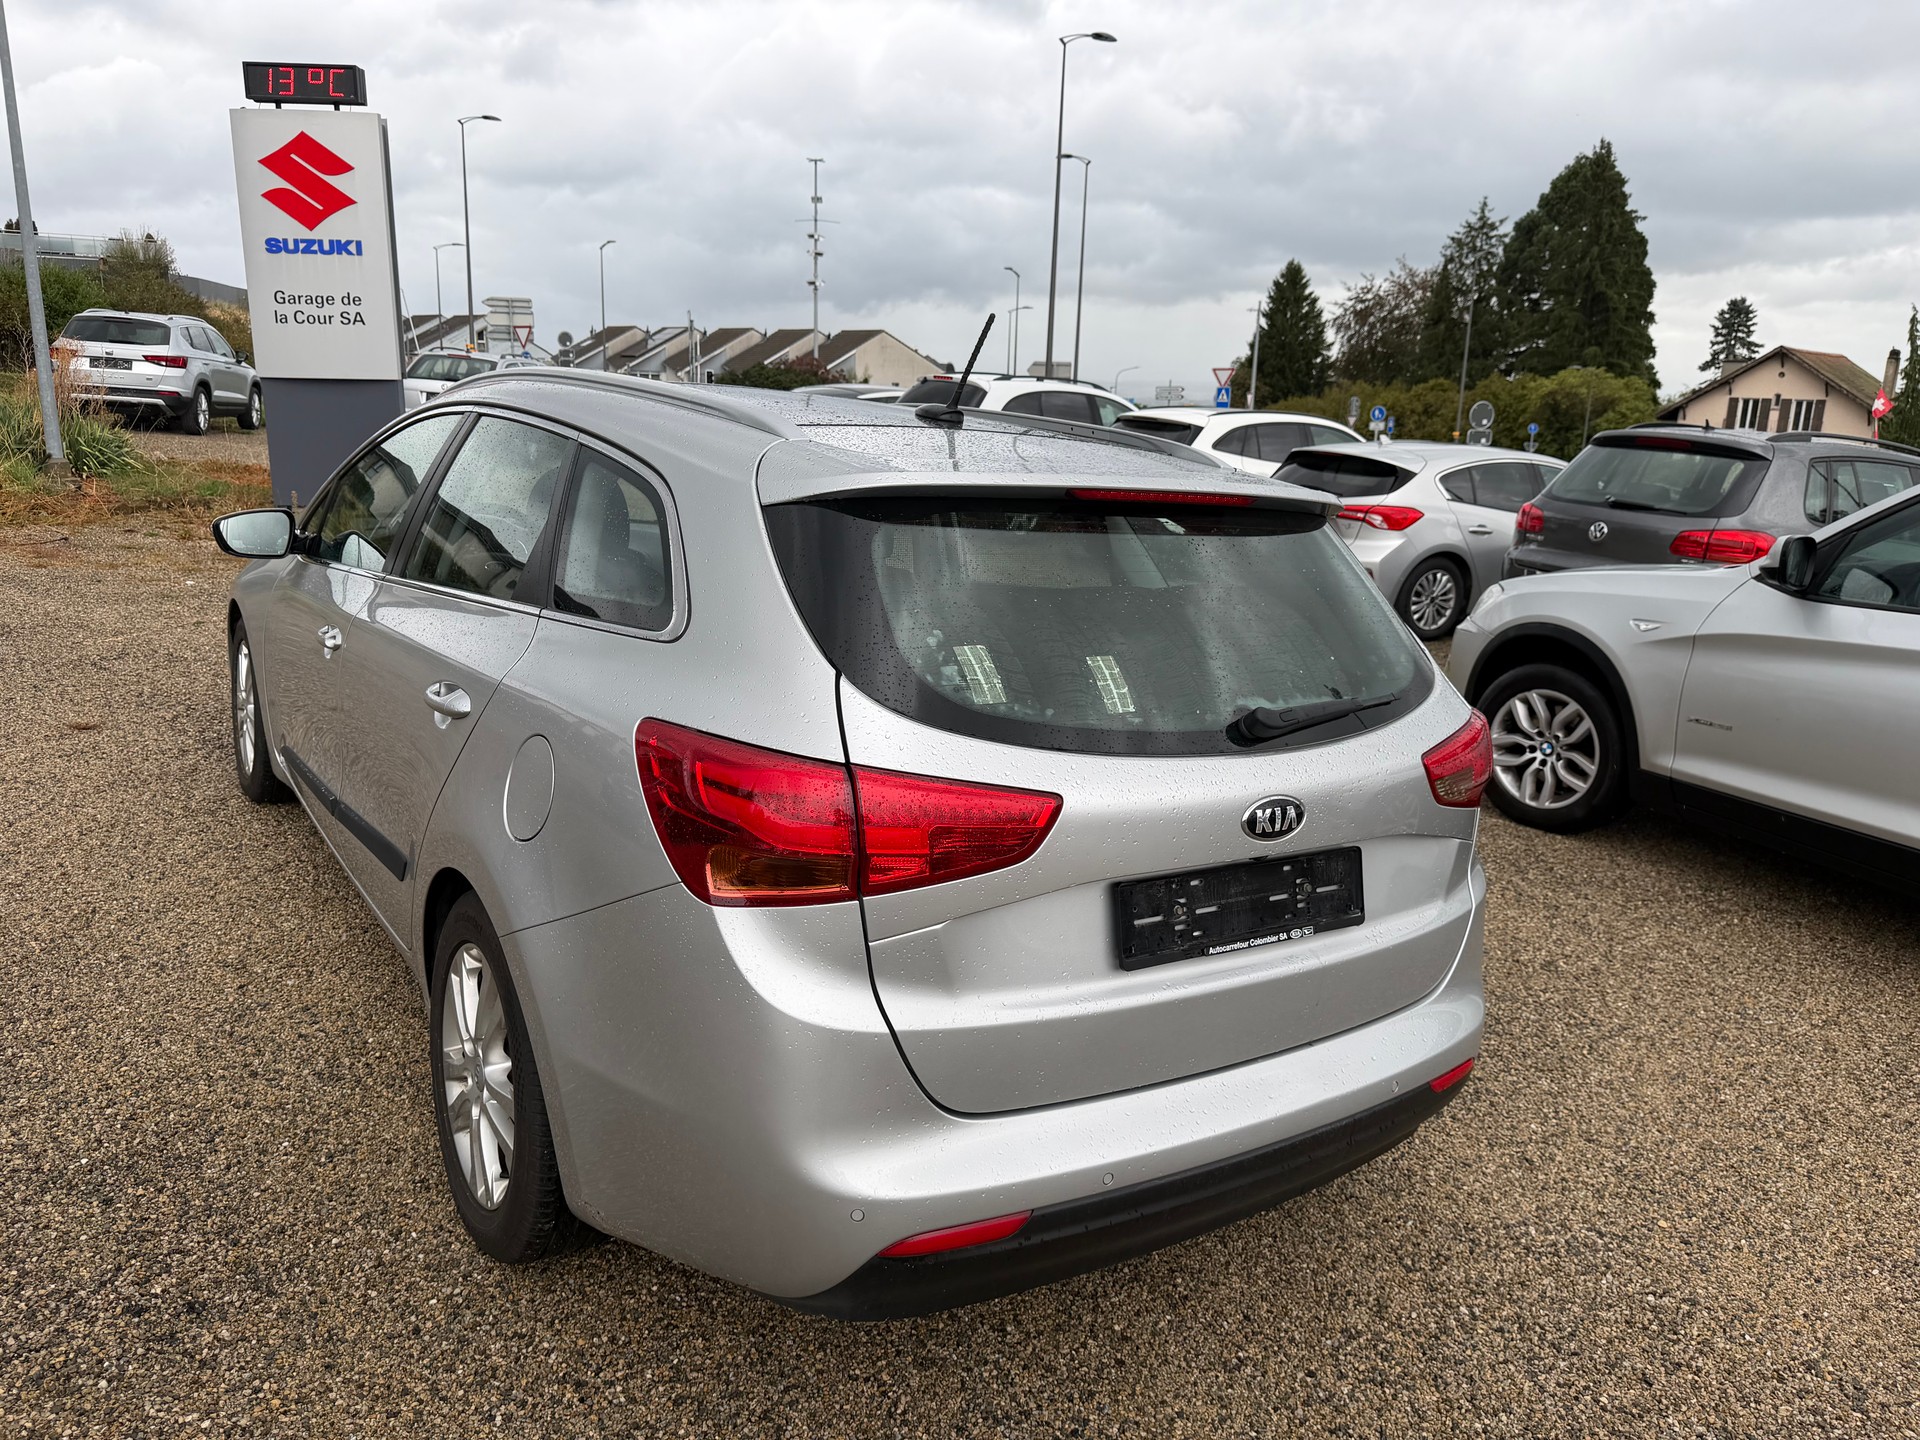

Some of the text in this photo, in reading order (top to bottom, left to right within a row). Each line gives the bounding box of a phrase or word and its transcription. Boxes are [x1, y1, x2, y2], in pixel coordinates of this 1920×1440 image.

[268, 67, 294, 95] 13
[264, 237, 363, 257] SUZUKI
[273, 290, 362, 309] Garage de
[274, 309, 366, 326] la Cour SA
[1255, 805, 1298, 834] KIA
[1208, 932, 1288, 955] Autocarrefour Colombier SA
